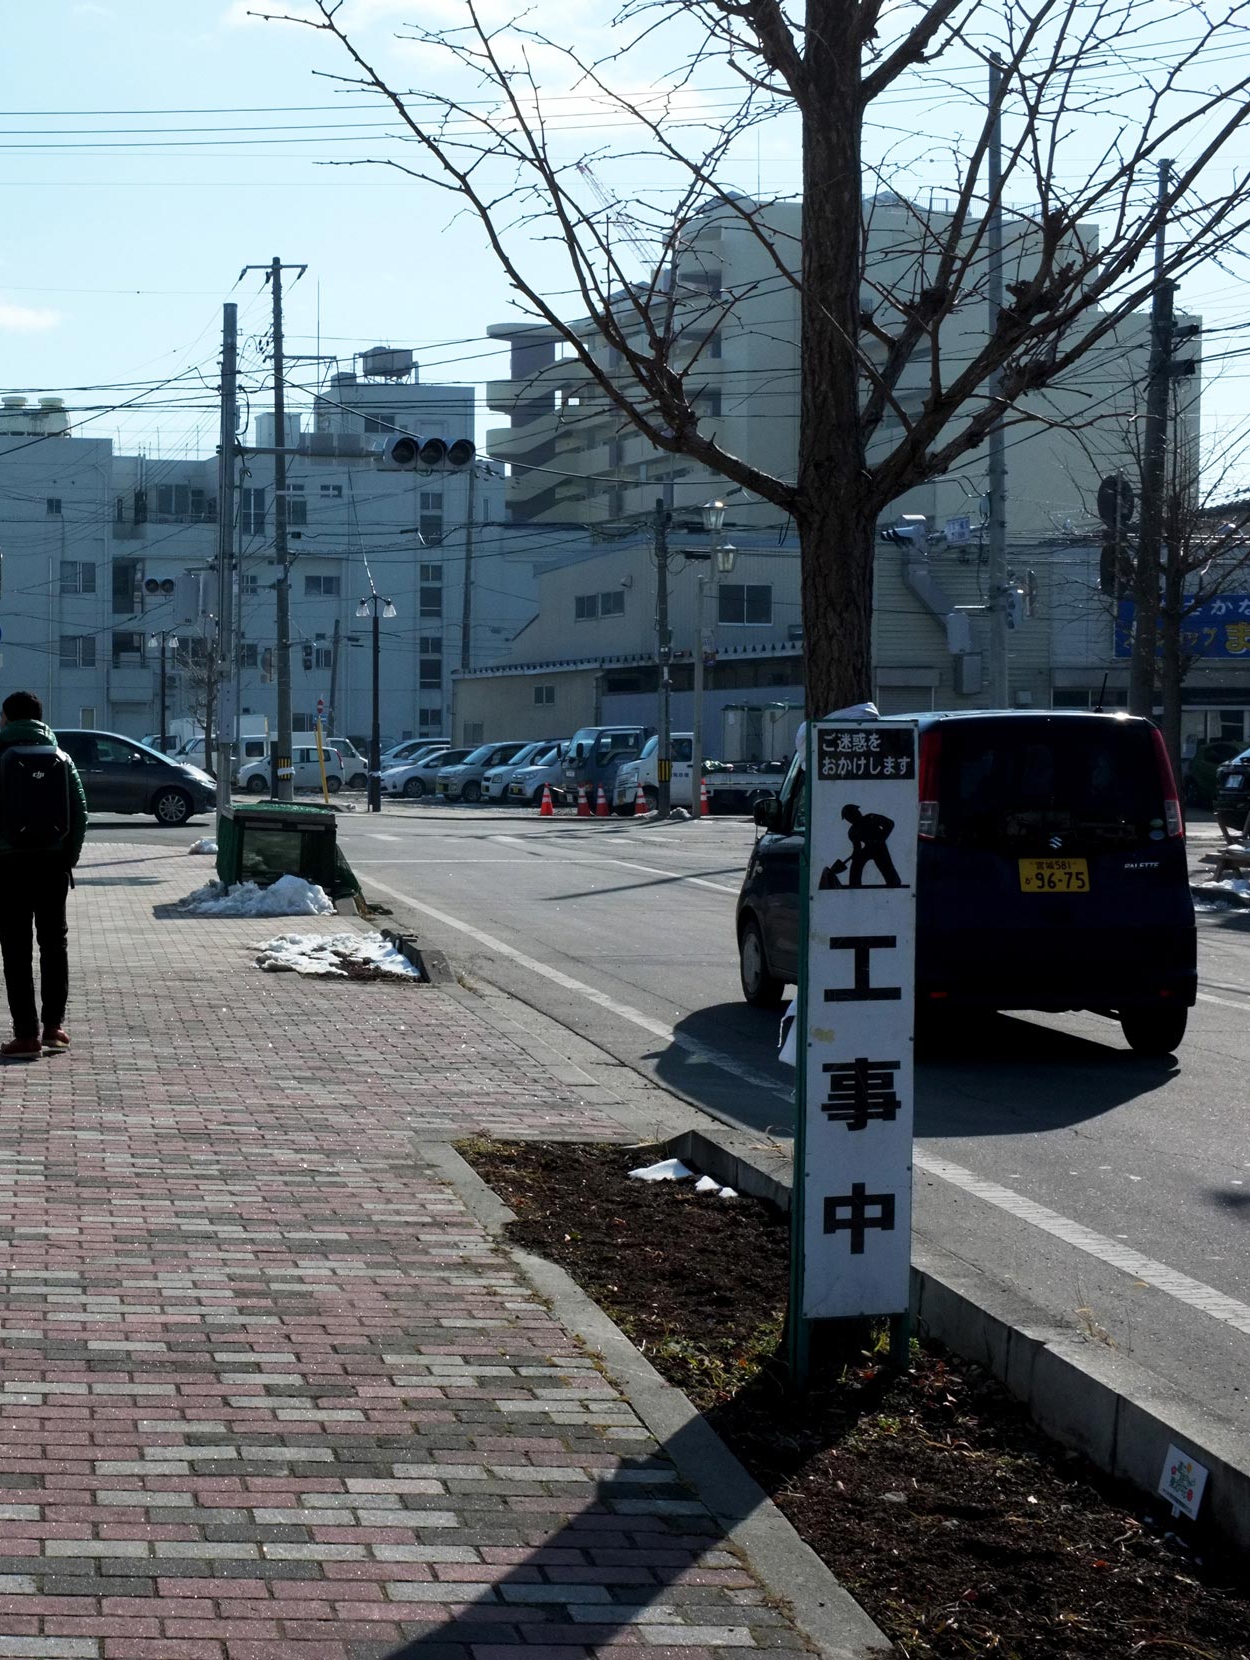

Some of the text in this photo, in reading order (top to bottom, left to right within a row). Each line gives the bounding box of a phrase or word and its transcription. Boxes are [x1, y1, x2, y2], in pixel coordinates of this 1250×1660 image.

[822, 732, 882, 752] ご迷惑を
[822, 756, 911, 776] おかけします
[1035, 872, 1086, 889] 96-75
[820, 935, 903, 1255] 工事中
